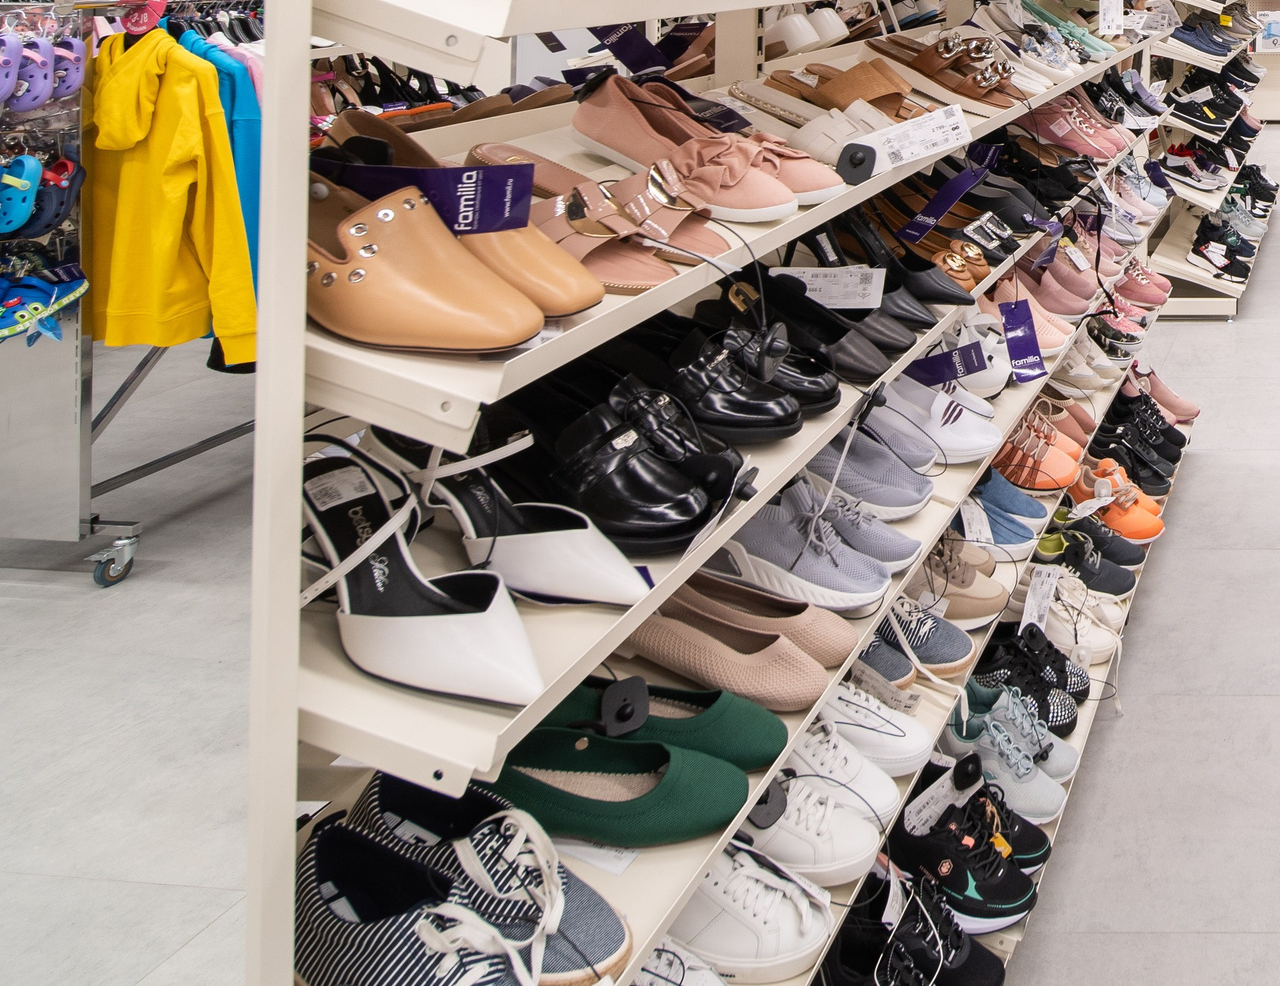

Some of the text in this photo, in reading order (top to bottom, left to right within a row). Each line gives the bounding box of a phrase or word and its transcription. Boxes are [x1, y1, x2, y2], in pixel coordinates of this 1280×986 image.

[602, 23, 633, 46] familia
[454, 170, 478, 231] familia
[504, 178, 514, 218] www.famil.ru
[914, 213, 938, 225] familia
[952, 350, 966, 377] familia
[1011, 355, 1041, 367] familia
[347, 505, 374, 547] betsy
